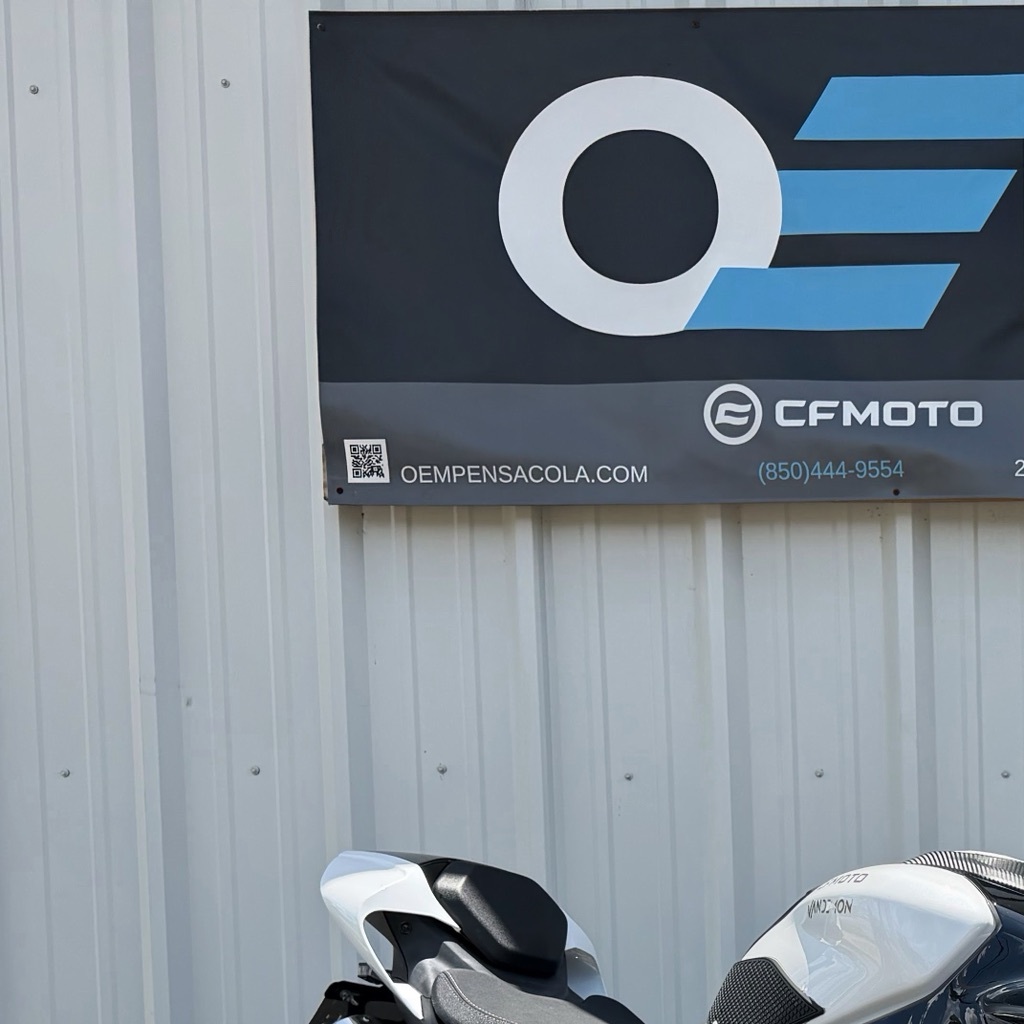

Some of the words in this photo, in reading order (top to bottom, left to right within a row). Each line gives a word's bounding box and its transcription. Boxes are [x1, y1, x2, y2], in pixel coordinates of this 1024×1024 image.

[775, 399, 983, 427] CFMOTO
[400, 464, 648, 484] OEMPENSACOLA.COM
[758, 459, 905, 485] (850)444-9554
